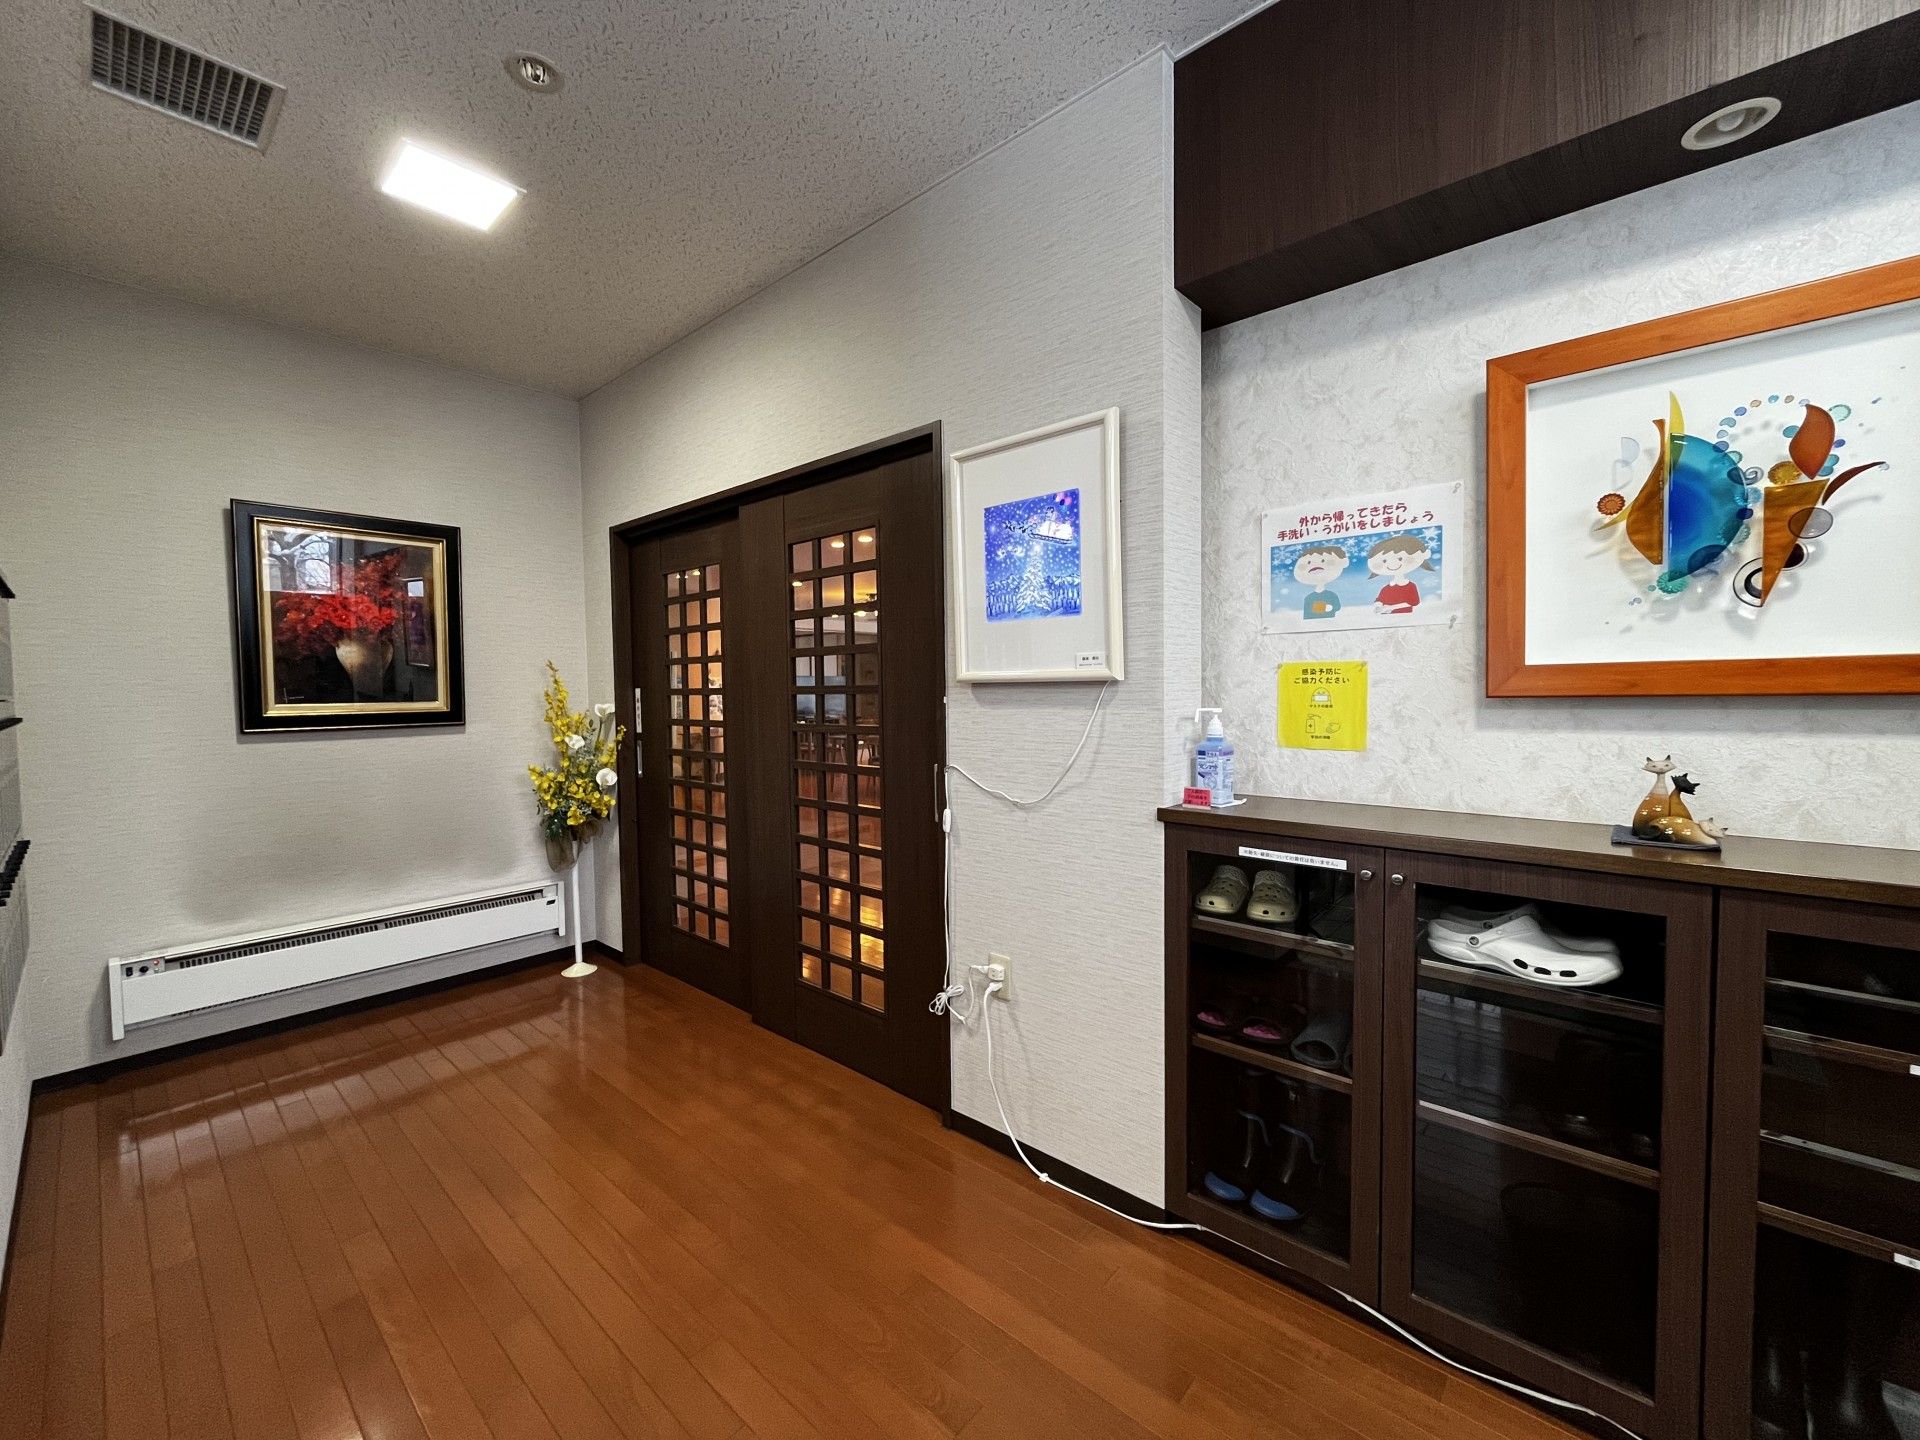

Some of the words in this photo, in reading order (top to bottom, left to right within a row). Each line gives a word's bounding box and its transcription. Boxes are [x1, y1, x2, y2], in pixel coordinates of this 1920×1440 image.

[1298, 502, 1408, 528] 外から帰ってきたら
[1277, 510, 1435, 542] 手洗い・うがいをしましょう
[1302, 668, 1341, 676] 感染予防に
[1294, 677, 1350, 685] ご協力ください
